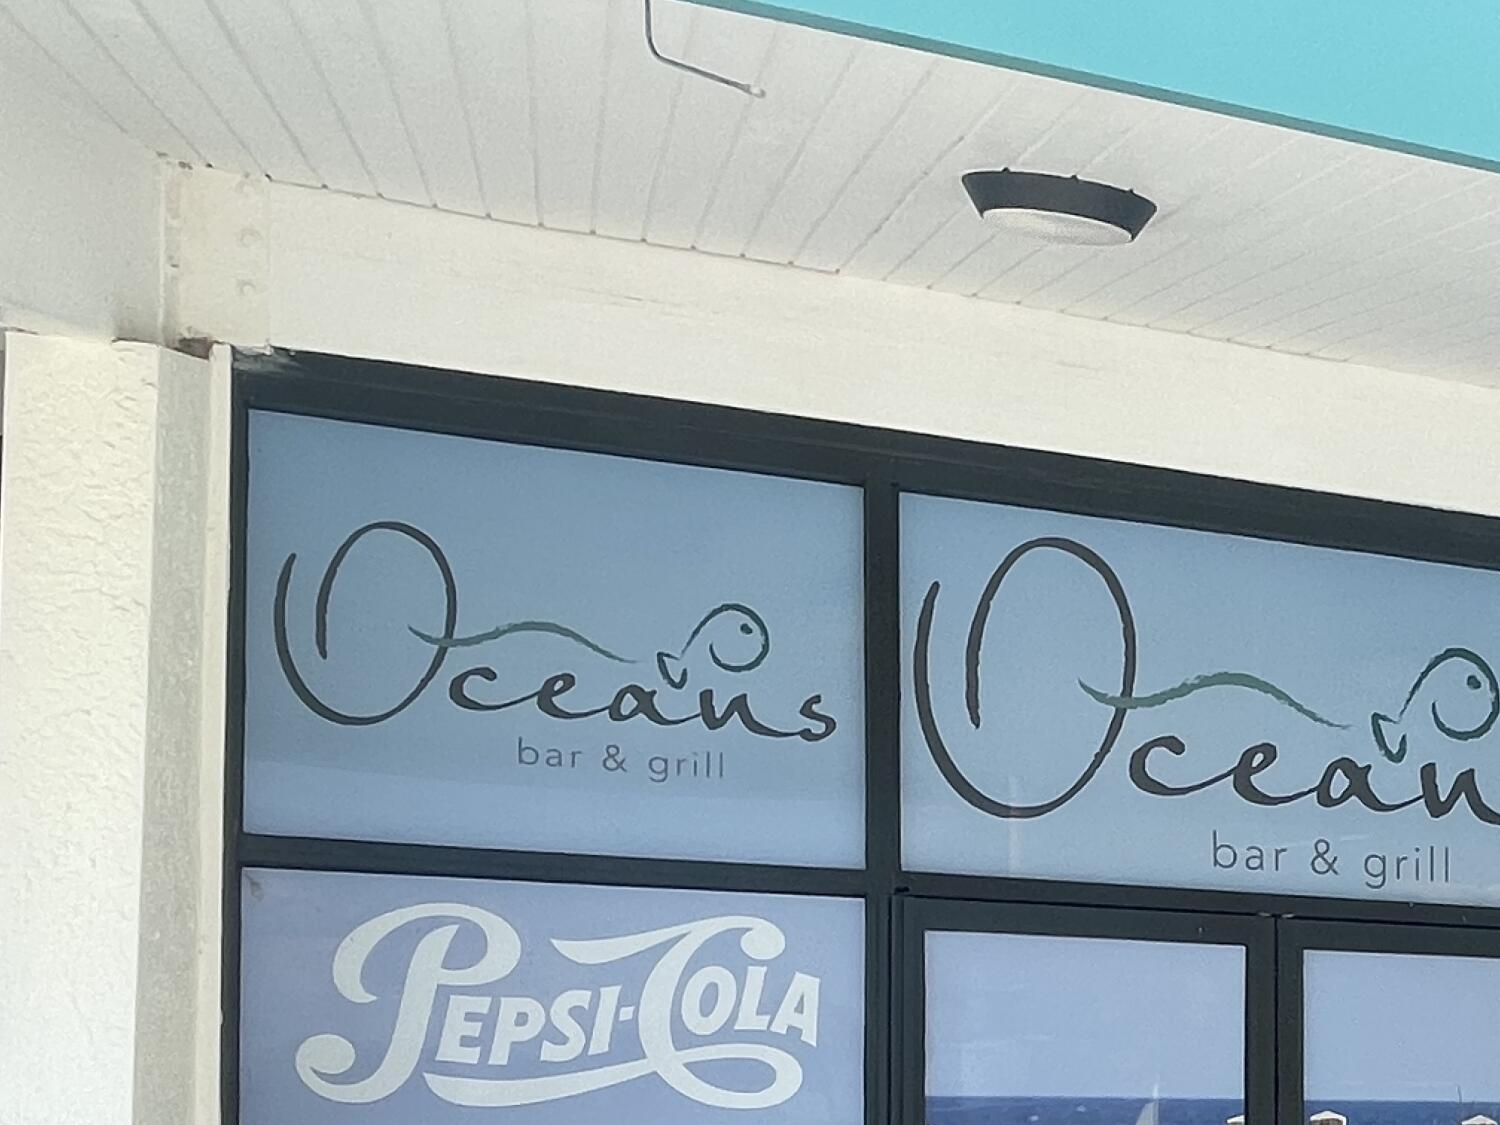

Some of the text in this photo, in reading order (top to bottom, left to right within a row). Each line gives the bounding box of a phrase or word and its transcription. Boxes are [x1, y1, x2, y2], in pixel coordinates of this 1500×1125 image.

[273, 520, 838, 742] Oceans
[516, 737, 726, 783] bar & grill
[1211, 830, 1451, 889] bar & grill
